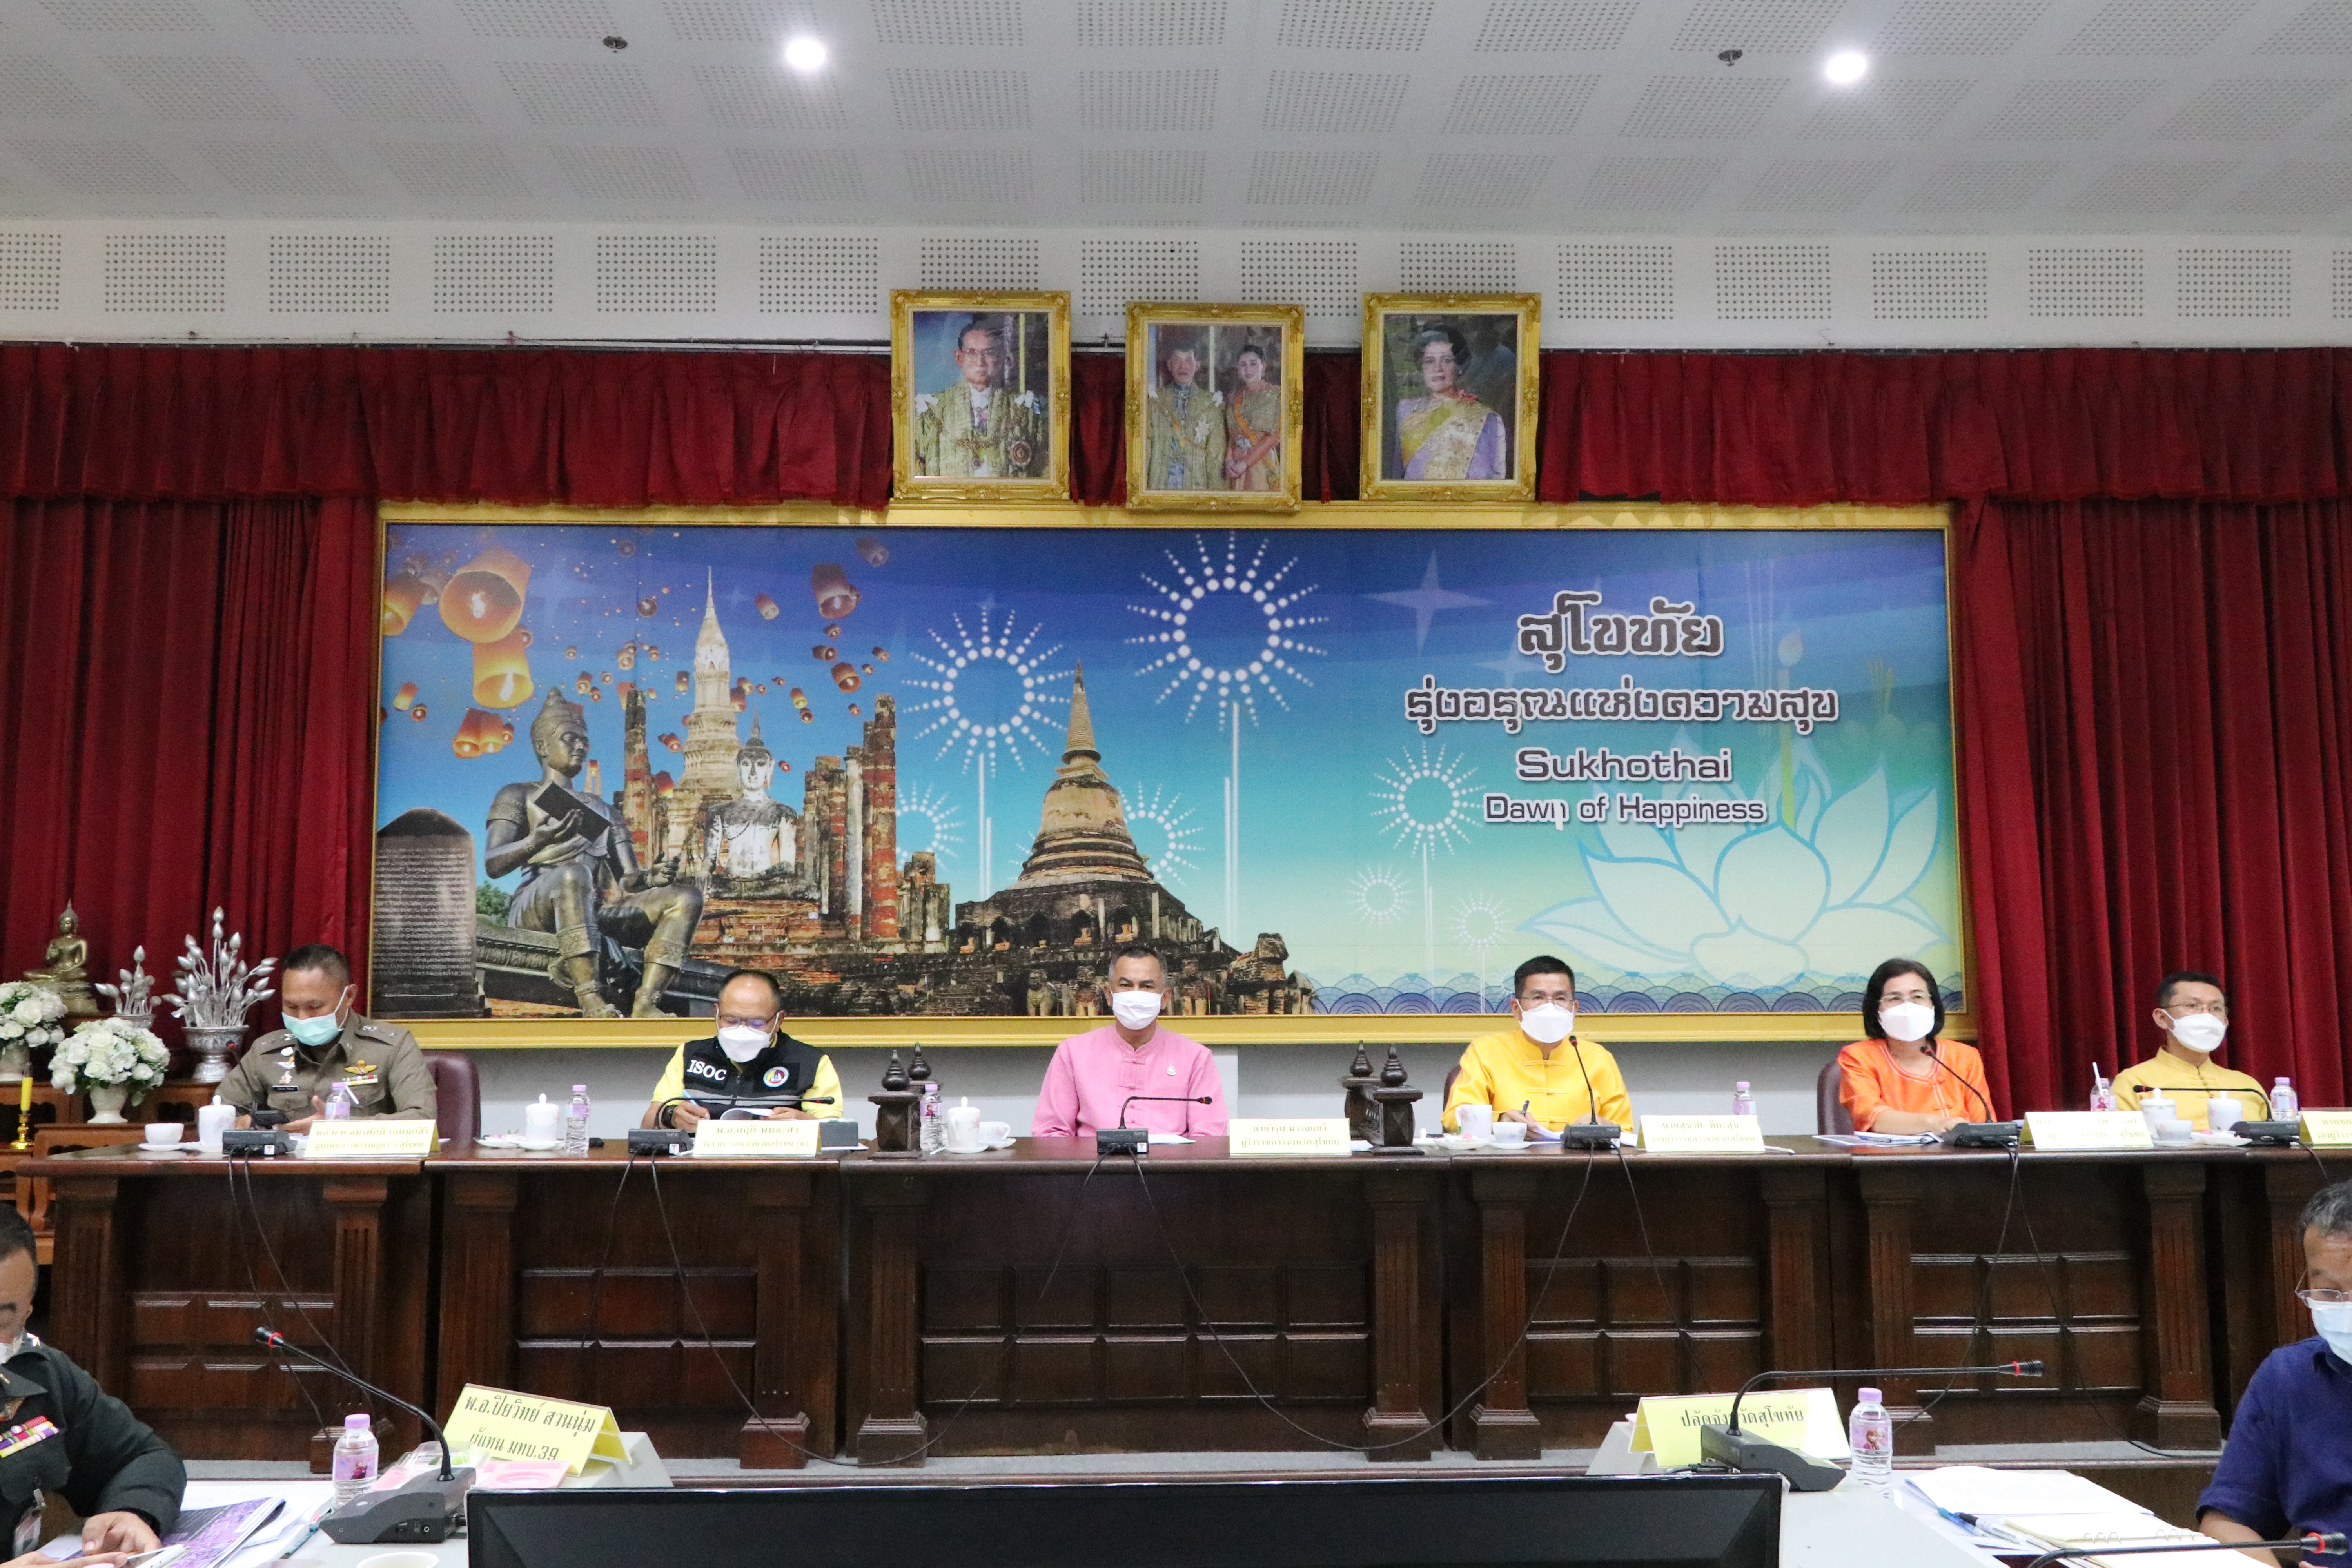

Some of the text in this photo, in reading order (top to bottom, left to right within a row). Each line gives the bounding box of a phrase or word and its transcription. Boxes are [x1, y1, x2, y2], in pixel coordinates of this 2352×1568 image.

[1519, 592, 1721, 671] สุโขทัย
[1406, 676, 1838, 733] รุ่งอรุณแห่งความสุข
[1518, 749, 1729, 779] Sukhothai
[1579, 795, 1606, 820] of
[1619, 795, 1764, 826] Happiness
[686, 1059, 727, 1081] ISOC
[1241, 1137, 1339, 1148] ผู้ว่าราชการจังหวัดสุโขทัย
[464, 1395, 597, 1437] พ.อ.ปิยวิทย์ สวนนุ่ม
[1680, 1405, 1804, 1428] ปลัดจังวัดสุโขทัย
[507, 1440, 559, 1461] มทบ.39
